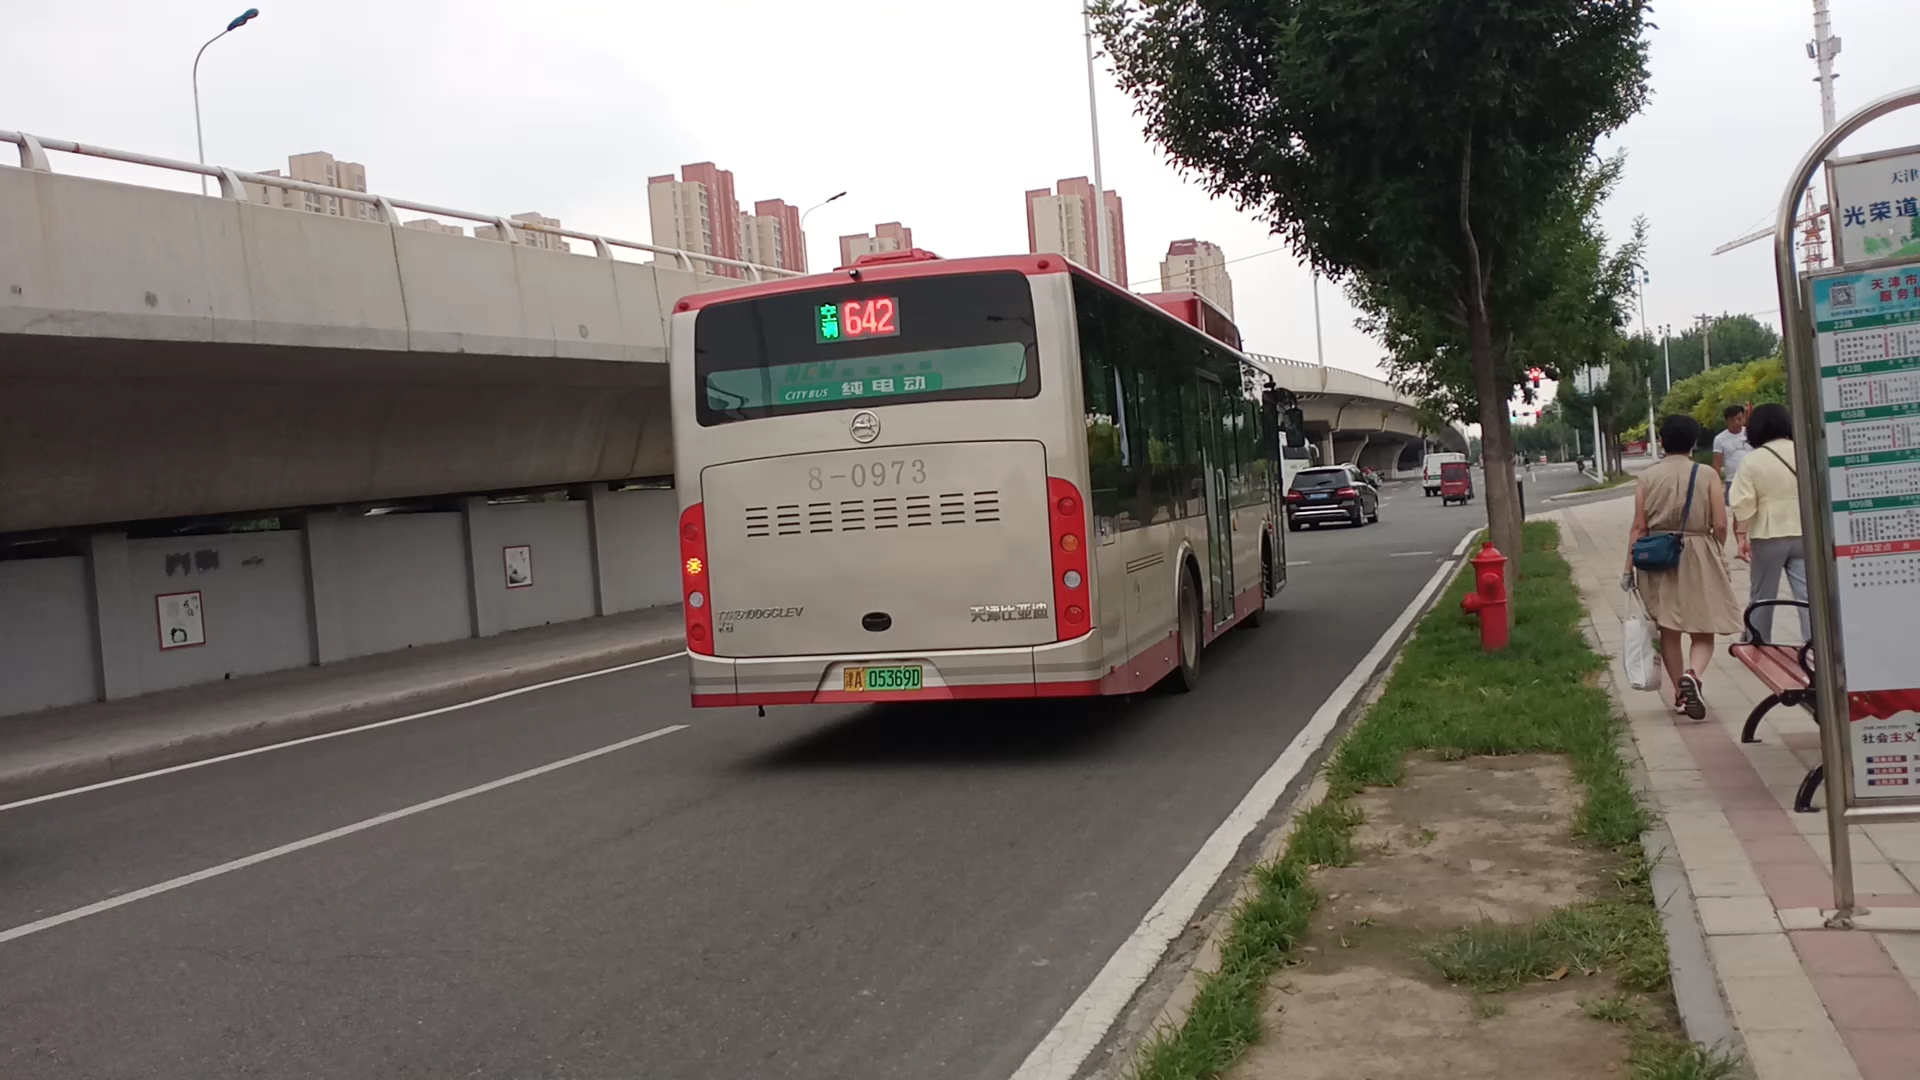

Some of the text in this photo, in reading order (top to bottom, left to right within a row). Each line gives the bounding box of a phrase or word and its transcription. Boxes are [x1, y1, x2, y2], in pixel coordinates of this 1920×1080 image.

[1843, 197, 1919, 227] 光荣道
[1872, 275, 1917, 290] 天津市
[820, 303, 839, 338] 空调
[844, 299, 894, 335] 642
[1837, 364, 1862, 374] 642路
[785, 388, 829, 400] CITY BUS
[841, 375, 926, 396] 纯电动
[808, 459, 927, 491] 8-0973
[970, 602, 1048, 623] 天津比亚迪
[869, 669, 920, 688] 05369D
[1862, 732, 1917, 744] 社会主义
